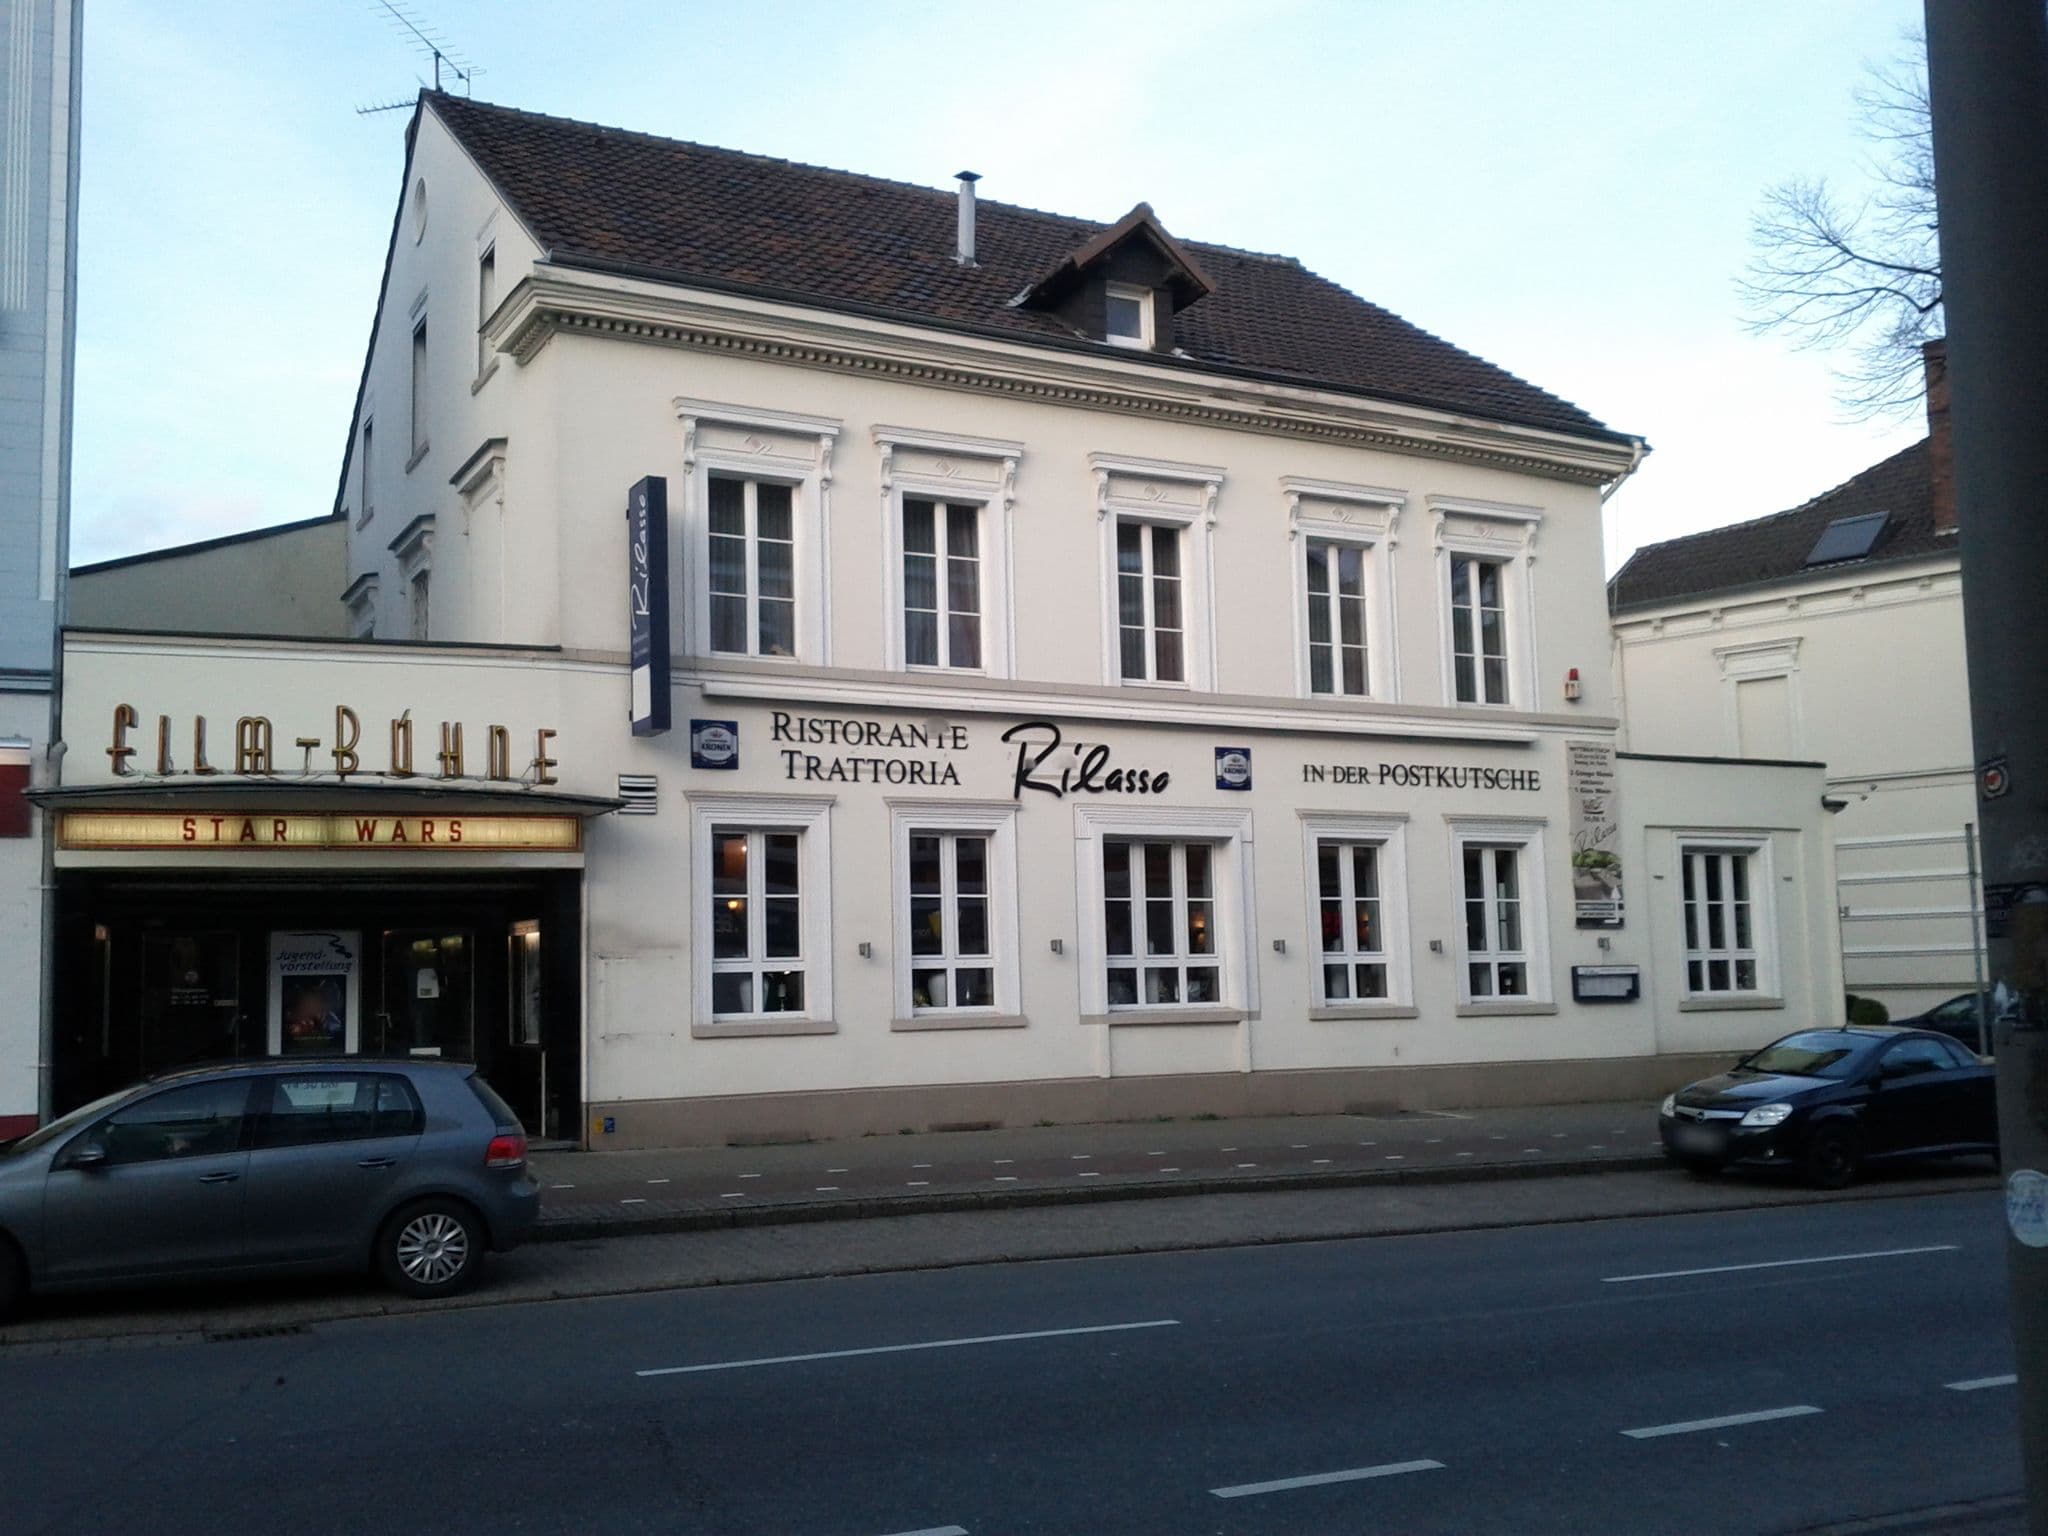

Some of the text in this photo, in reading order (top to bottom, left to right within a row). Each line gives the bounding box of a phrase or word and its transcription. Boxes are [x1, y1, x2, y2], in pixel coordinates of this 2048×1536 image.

[781, 750, 961, 786] TRATTORIA
[1001, 722, 1170, 799] Rilasso
[1303, 764, 1541, 791] IN DER POSTKUTSCHE
[182, 818, 462, 843] STAR WARS
